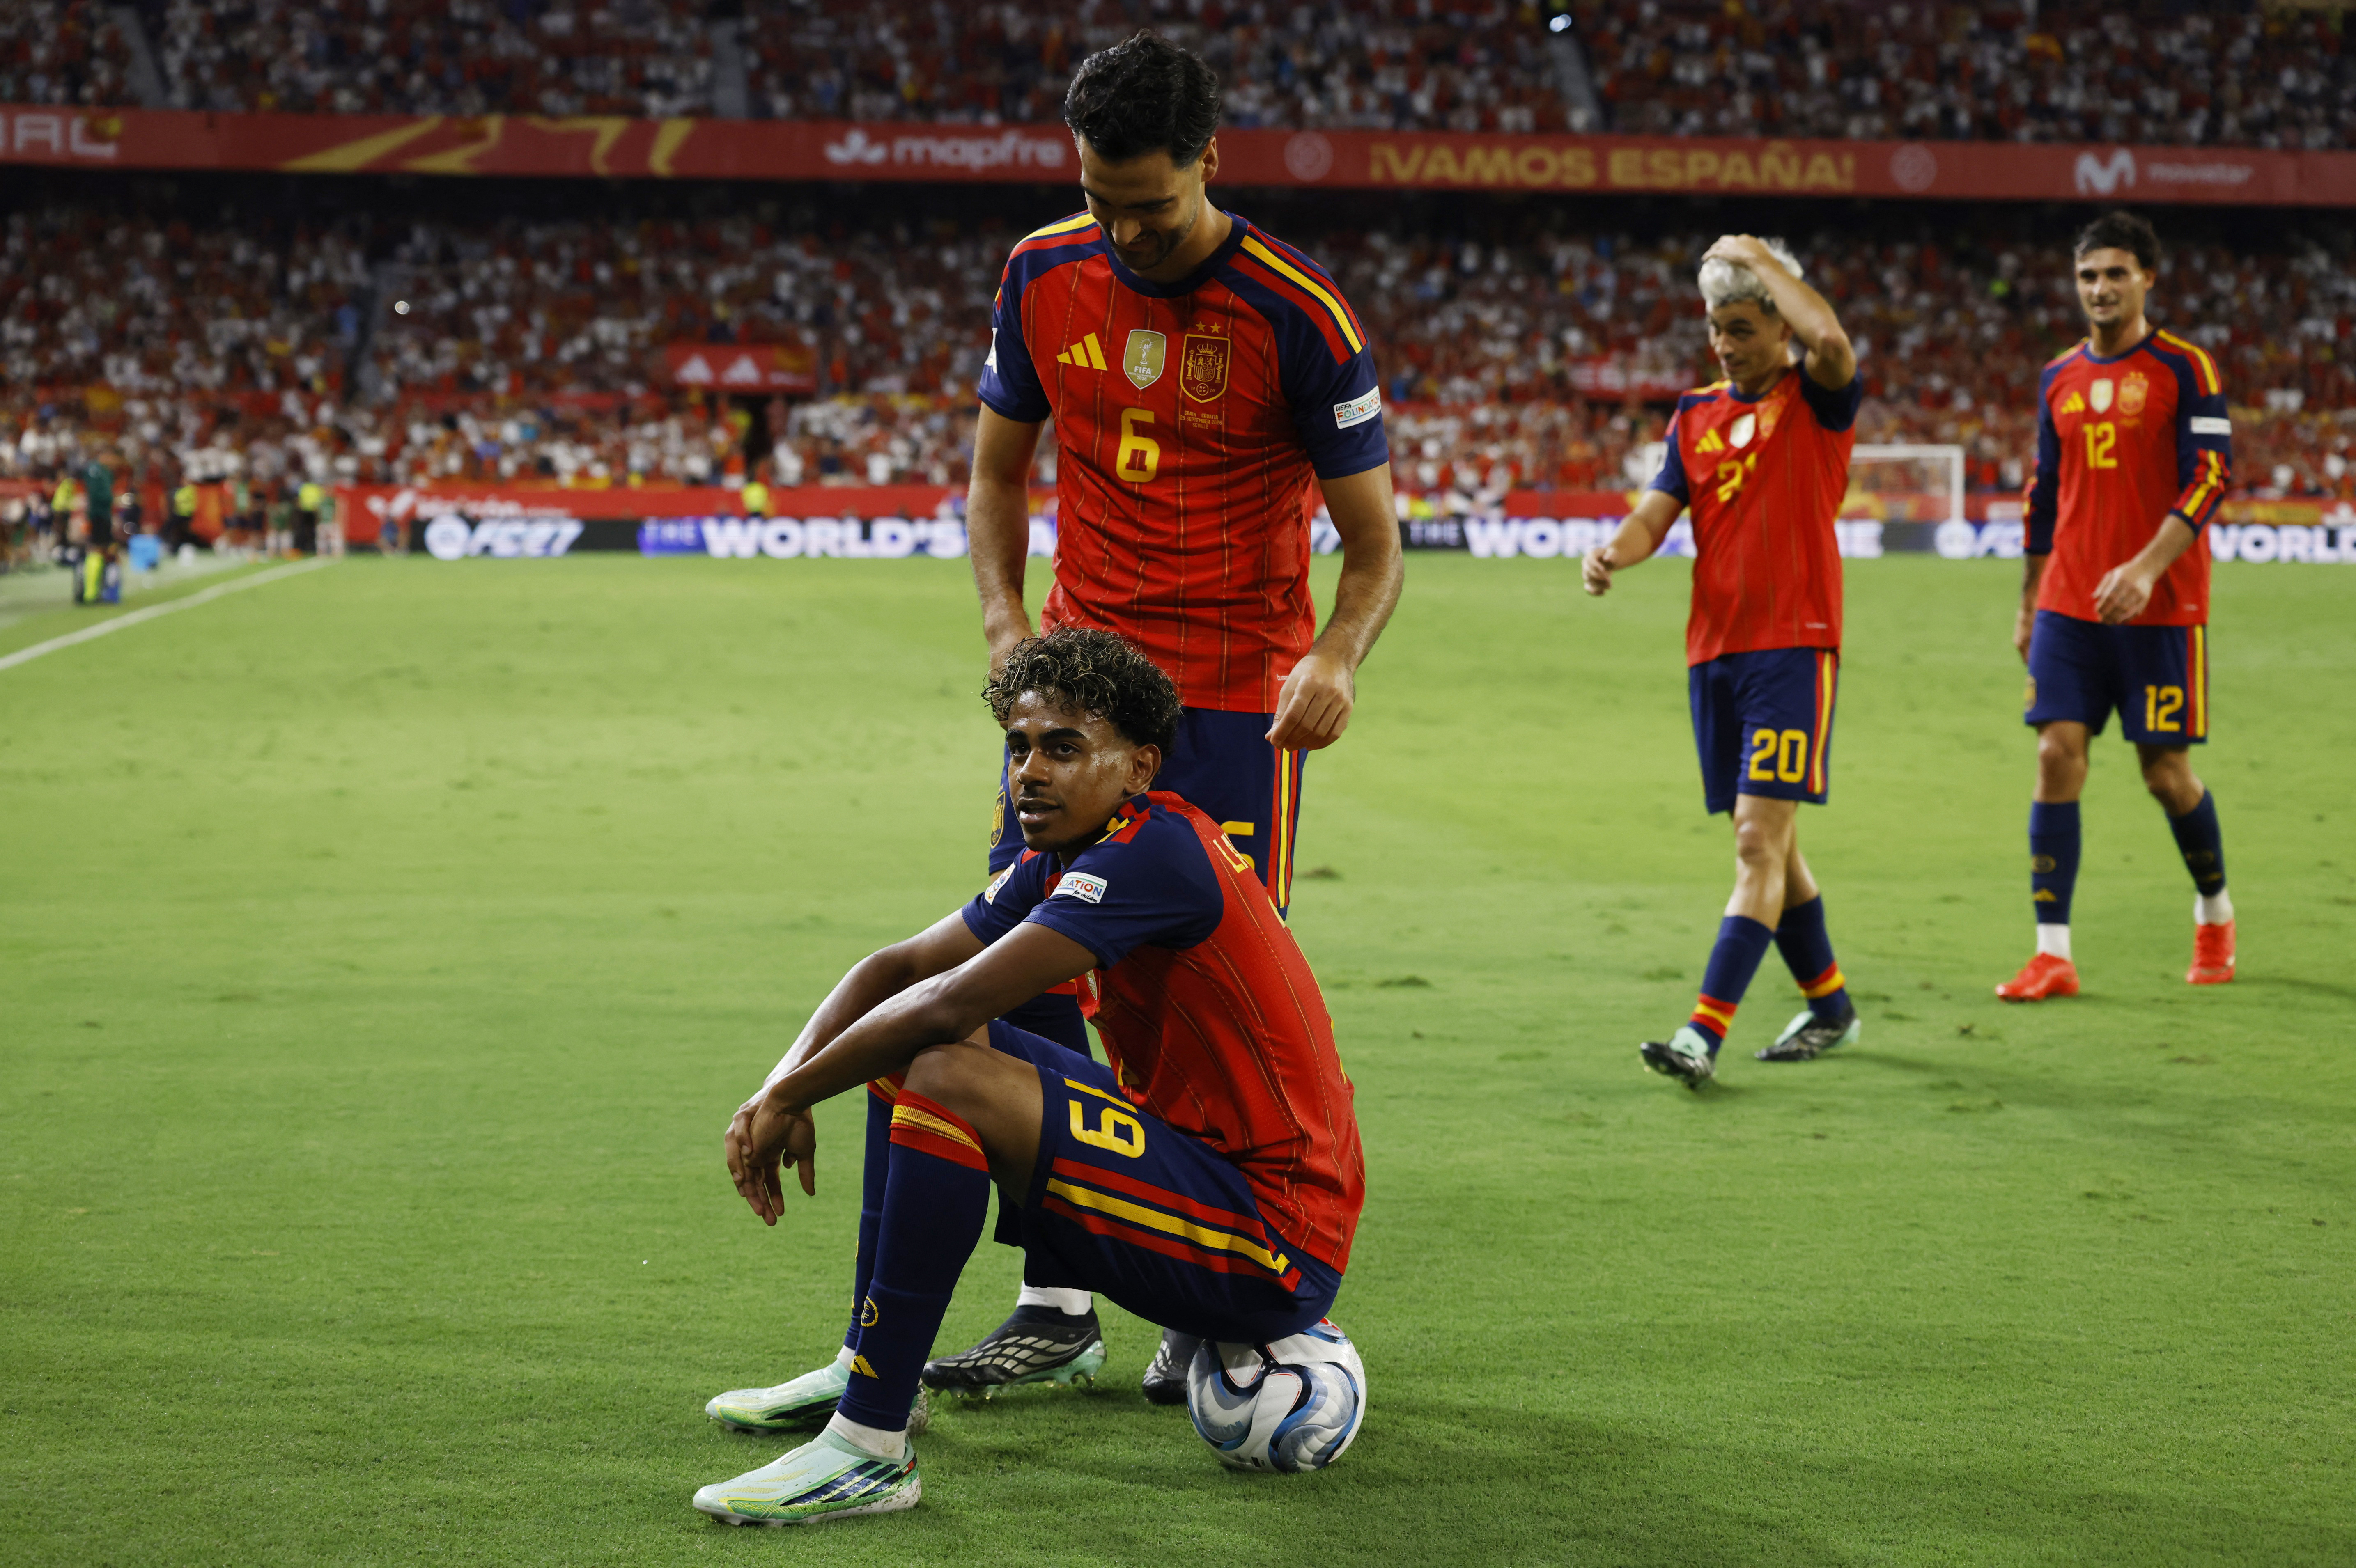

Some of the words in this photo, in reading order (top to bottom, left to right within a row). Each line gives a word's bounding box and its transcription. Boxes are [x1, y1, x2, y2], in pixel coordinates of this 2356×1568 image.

[1134, 366, 1151, 374] FIFA
[1116, 407, 1160, 483] 6
[2083, 422, 2117, 469] 12
[699, 516, 967, 558] WORLD'S
[2145, 685, 2184, 732] 12
[1748, 728, 1807, 783] 20
[1080, 893, 1098, 903] children
[1063, 1077, 1145, 1158] 19
